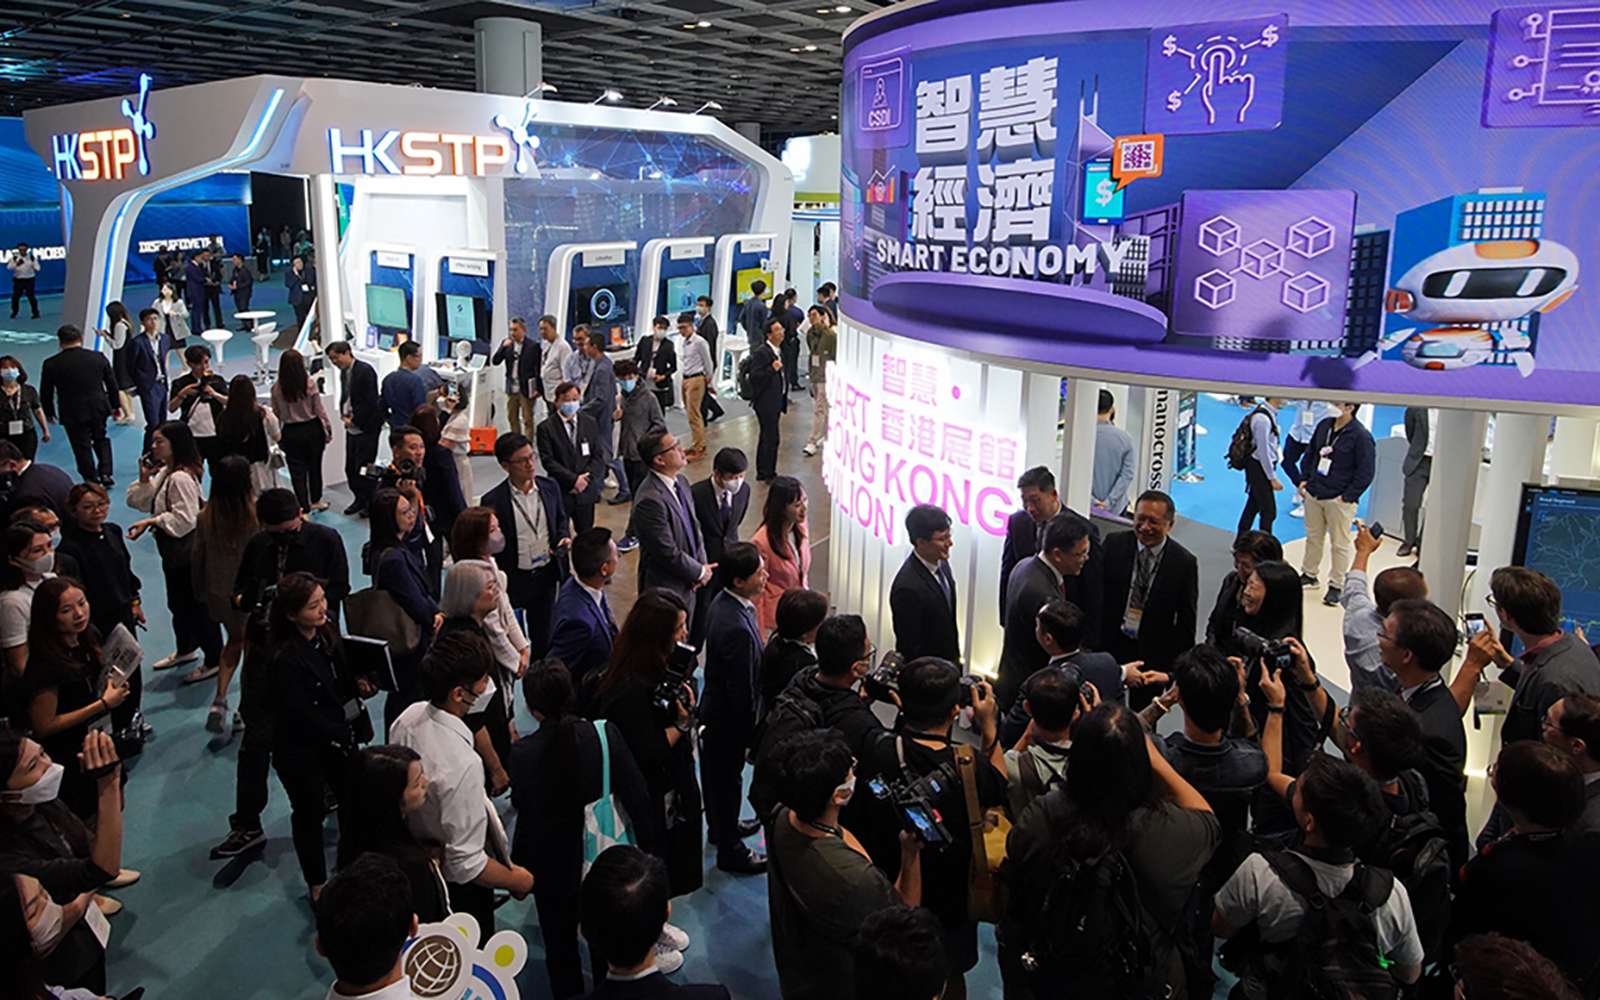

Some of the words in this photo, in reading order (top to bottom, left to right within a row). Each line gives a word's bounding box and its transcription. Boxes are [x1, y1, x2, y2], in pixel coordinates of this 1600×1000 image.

[915, 56, 1058, 155] 智慧
[52, 128, 136, 180] HKSTP
[328, 128, 510, 176] HKSTP
[912, 158, 1055, 242] 經濟
[876, 238, 944, 270] SMART
[950, 240, 1133, 275] ECONOMY
[881, 403, 1018, 481] 香港展館
[1150, 390, 1168, 490] nanocross
[884, 452, 1013, 537] KONG
